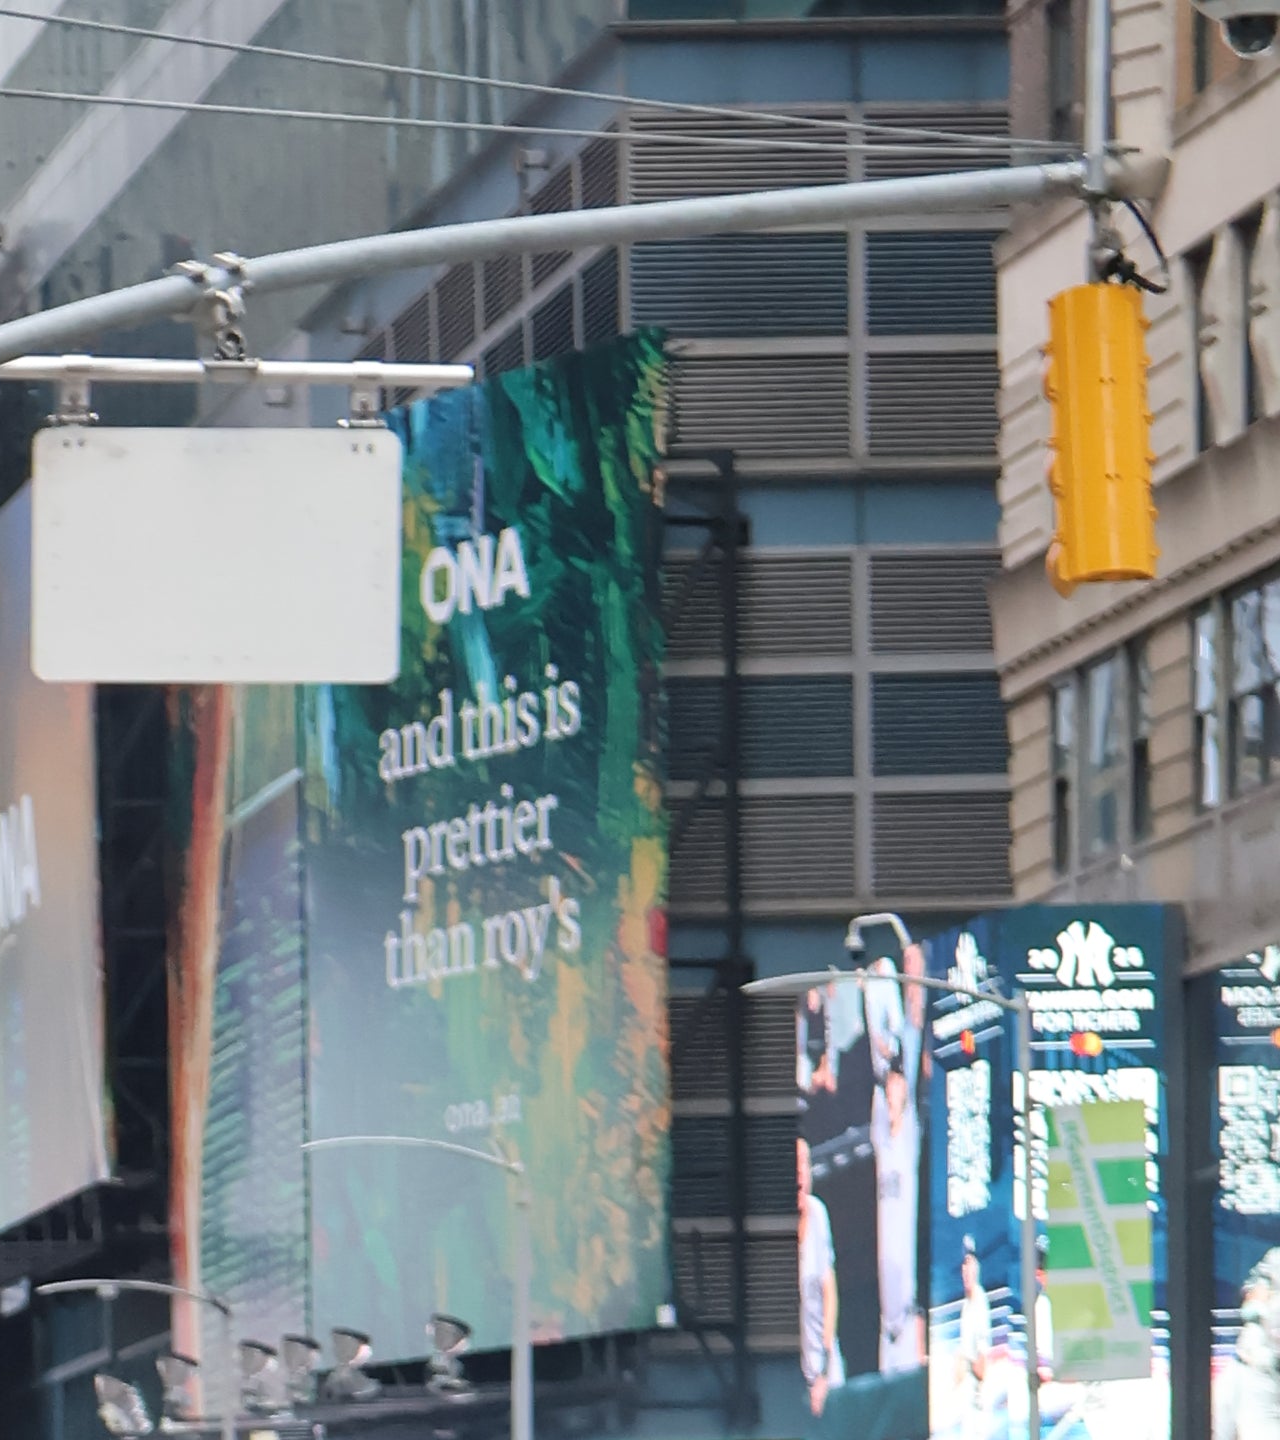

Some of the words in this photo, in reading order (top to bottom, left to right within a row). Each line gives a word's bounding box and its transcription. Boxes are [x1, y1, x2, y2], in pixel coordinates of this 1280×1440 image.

[420, 526, 530, 624] ONA
[378, 689, 455, 782] and
[460, 675, 539, 760] this
[543, 663, 582, 740] is
[402, 783, 558, 901] prettier
[384, 910, 476, 988] than
[482, 875, 581, 982] roy's
